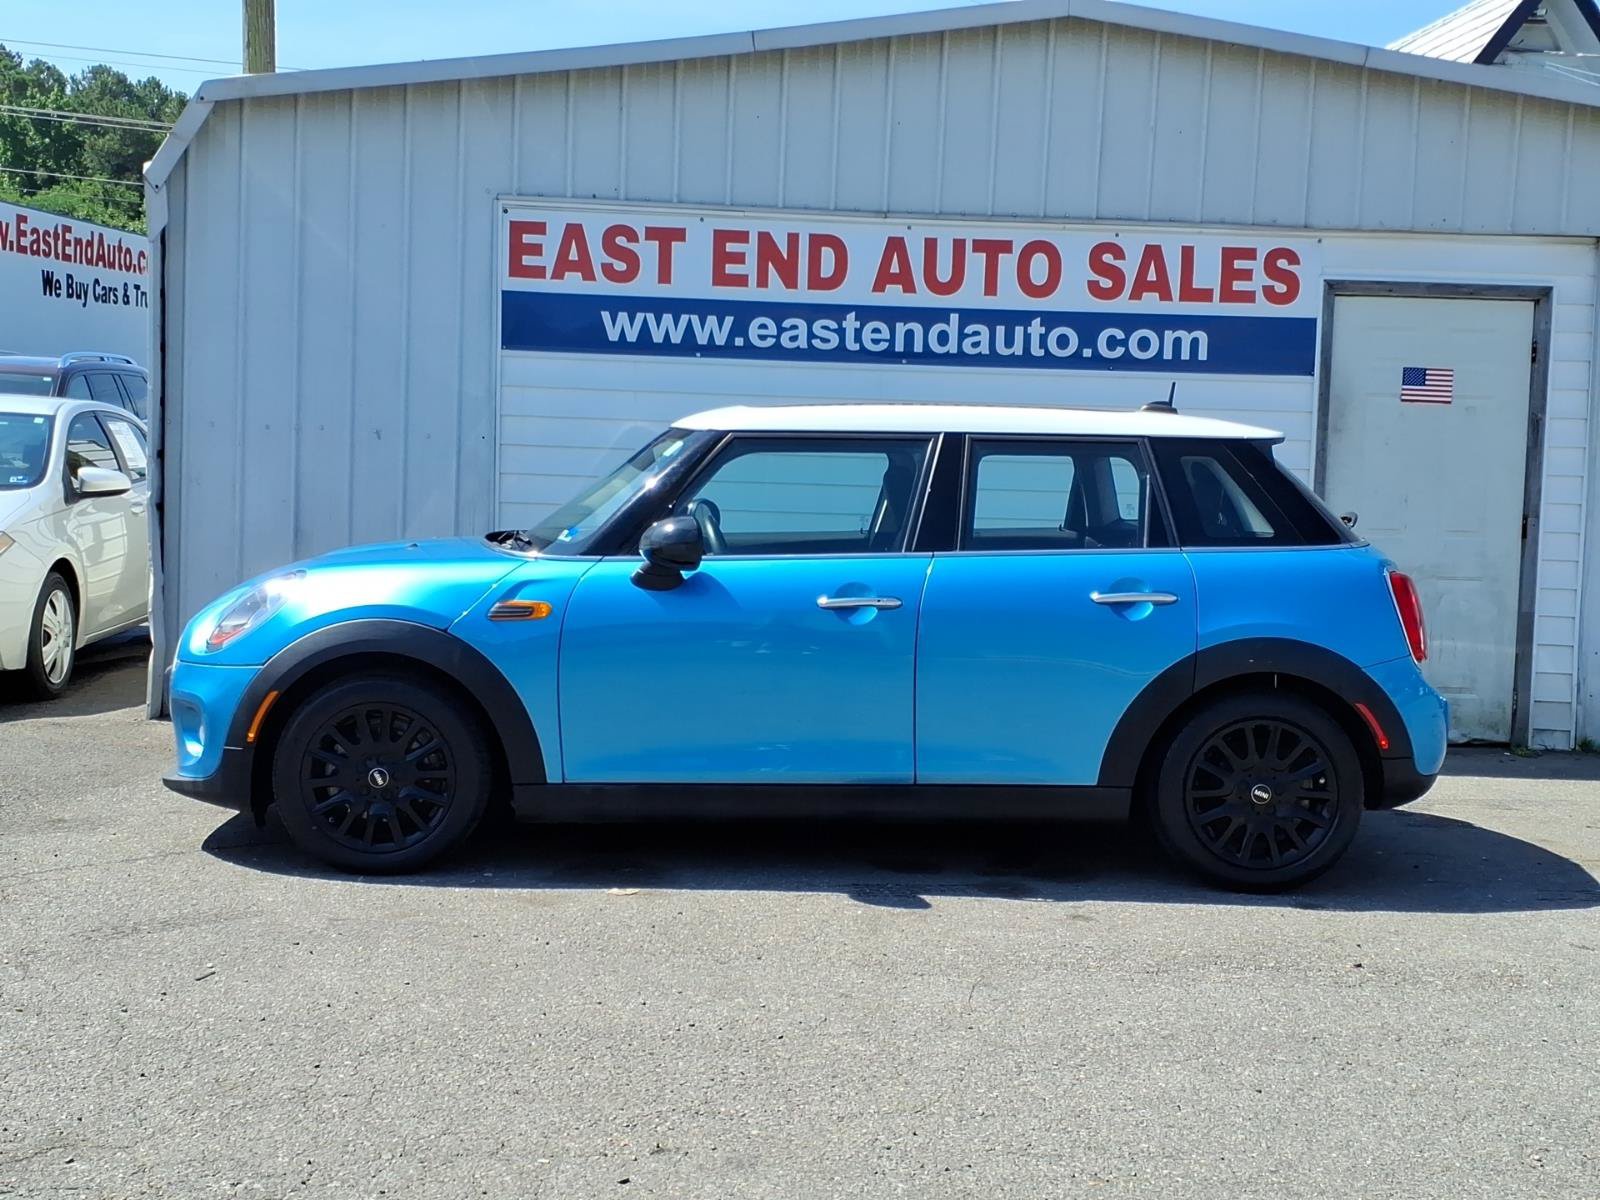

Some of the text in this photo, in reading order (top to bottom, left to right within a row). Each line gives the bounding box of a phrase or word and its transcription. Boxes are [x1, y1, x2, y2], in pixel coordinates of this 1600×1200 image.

[0, 213, 149, 275] .EastEndAuto.c
[508, 220, 1302, 306] EAST END AUTO SALES
[41, 269, 62, 298] We
[66, 273, 89, 308] Buy
[93, 278, 119, 305] Cars
[122, 282, 131, 306] &
[600, 310, 1209, 361] www.eastendauto.com
